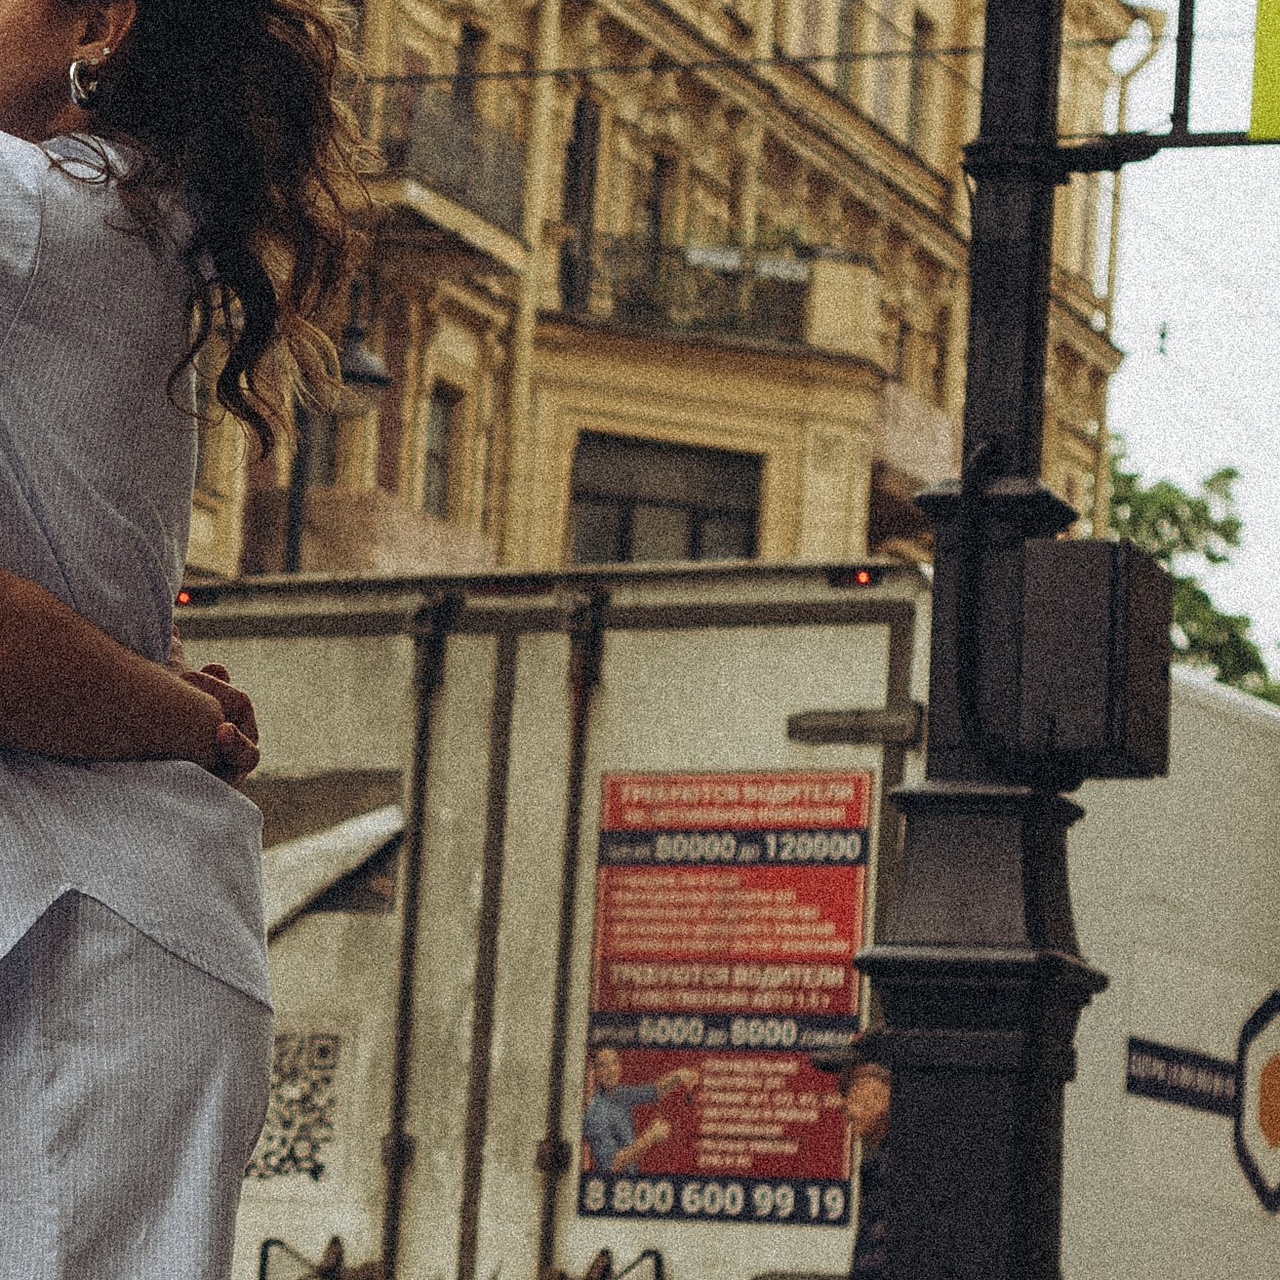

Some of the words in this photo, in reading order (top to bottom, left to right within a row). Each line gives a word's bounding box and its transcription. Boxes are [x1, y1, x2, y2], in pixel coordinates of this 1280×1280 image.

[585, 1178, 606, 1211] 8
[613, 1181, 674, 1213] 800
[681, 1182, 744, 1215] 600
[752, 1183, 795, 1217] 99
[806, 1185, 845, 1219] 19
